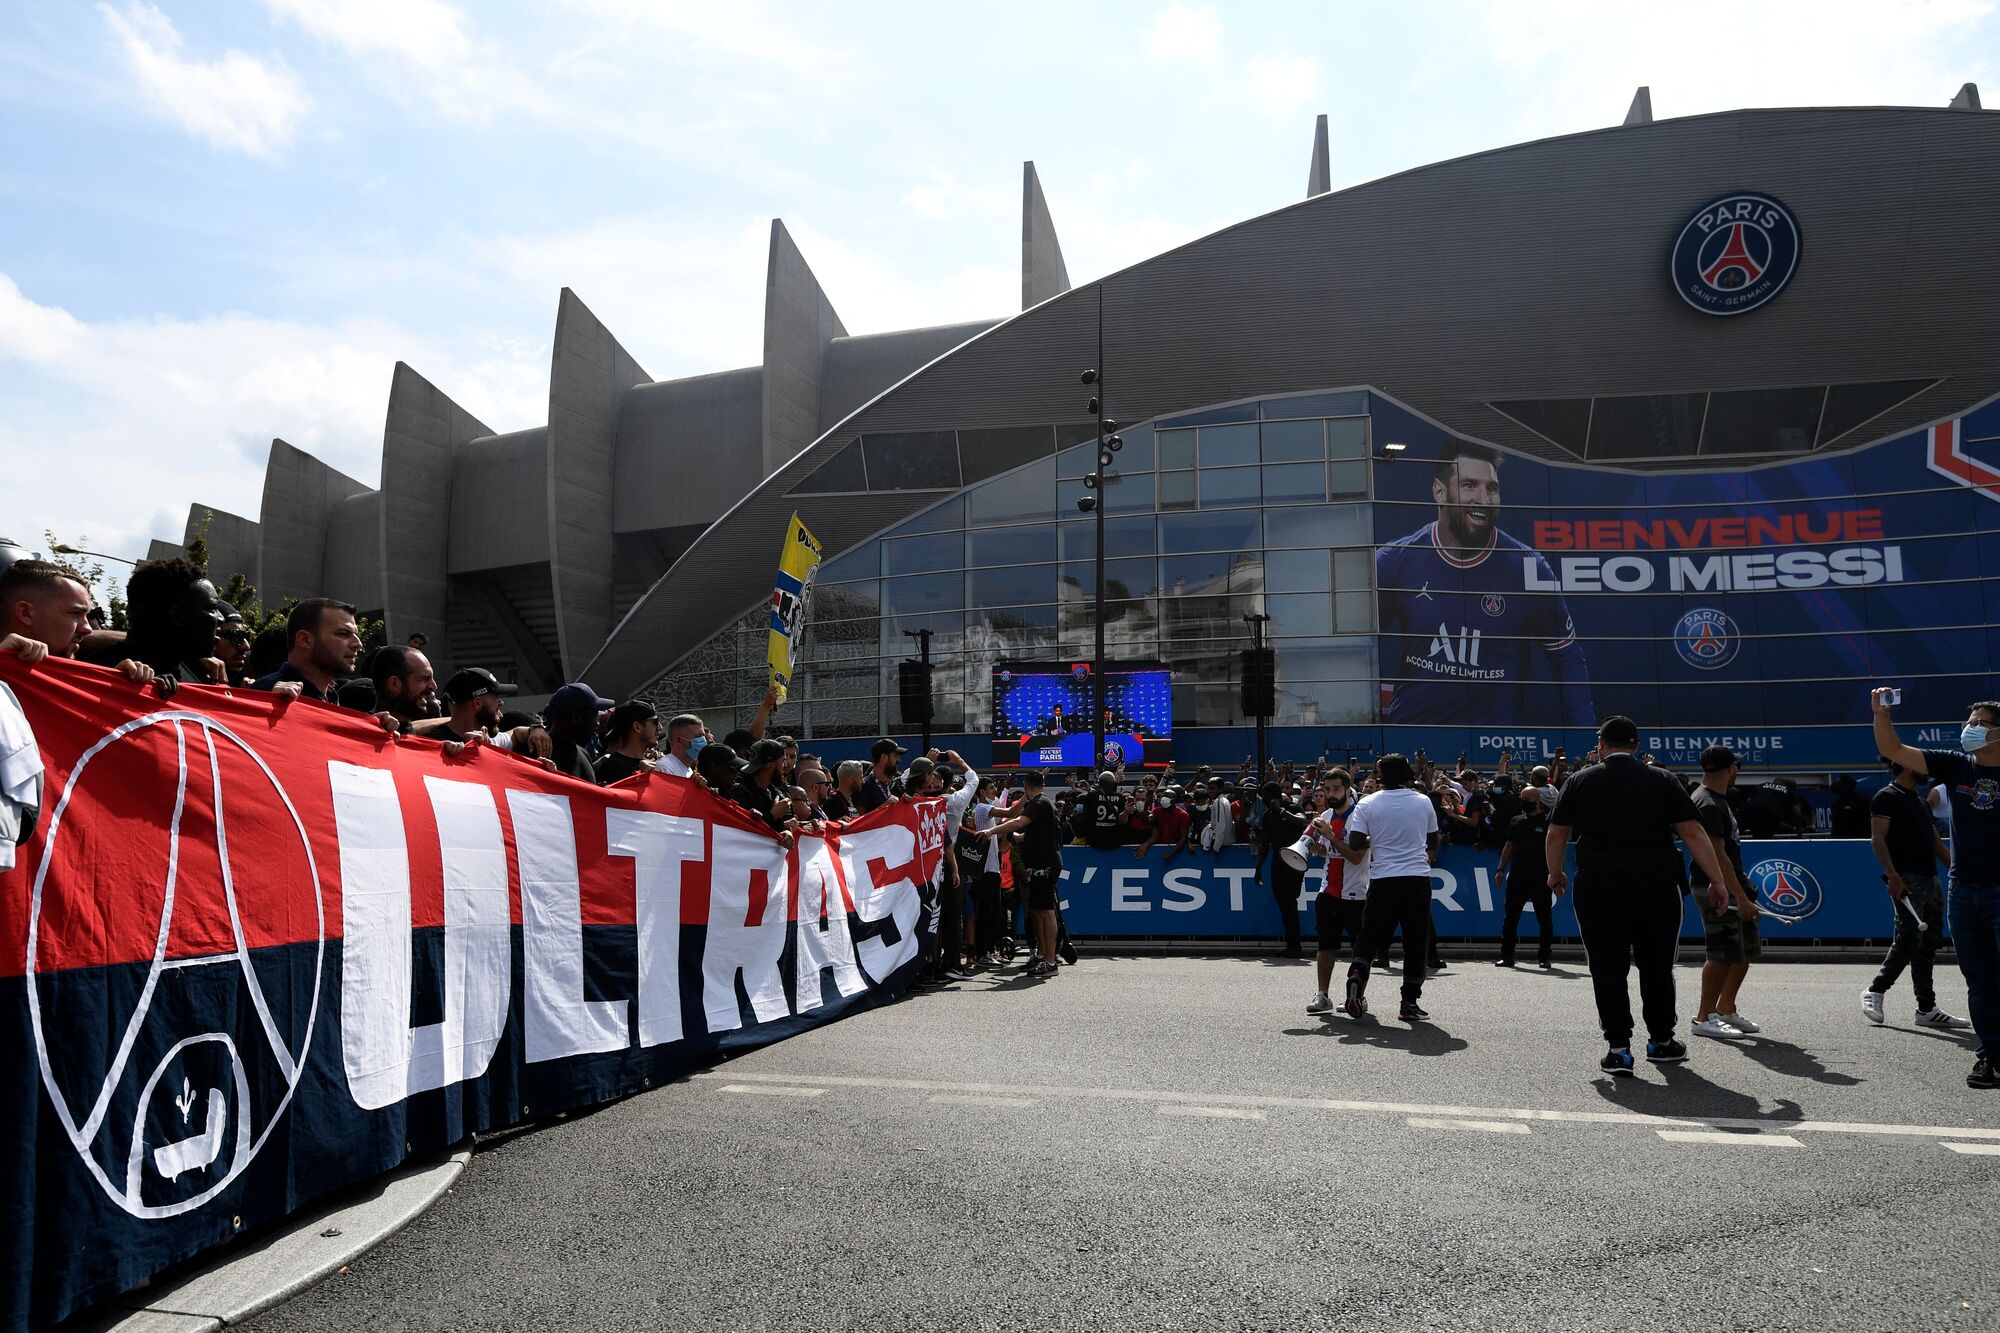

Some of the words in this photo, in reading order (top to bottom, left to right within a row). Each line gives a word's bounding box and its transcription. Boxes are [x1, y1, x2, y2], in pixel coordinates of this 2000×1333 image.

[1697, 202, 1780, 233] PARIS
[1533, 509, 1886, 550] BIENVENUE
[1523, 556, 1655, 592] LEO
[1669, 545, 1903, 592] MESSI
[1684, 611, 1727, 626] PARIS
[1406, 655, 1434, 671] ACCOR
[1435, 664, 1457, 676] LIVE
[1458, 667, 1505, 679] LIMITLESS
[1479, 736, 1537, 749] PORTE
[1542, 738, 1556, 758] L
[1649, 736, 1784, 750] BIENVENUE
[1509, 750, 1537, 762] ATE
[1669, 750, 1763, 762] WEME
[1755, 861, 1802, 877] PARIS
[1296, 867, 1557, 912] PRI
[328, 760, 921, 1110] ULTRAS
